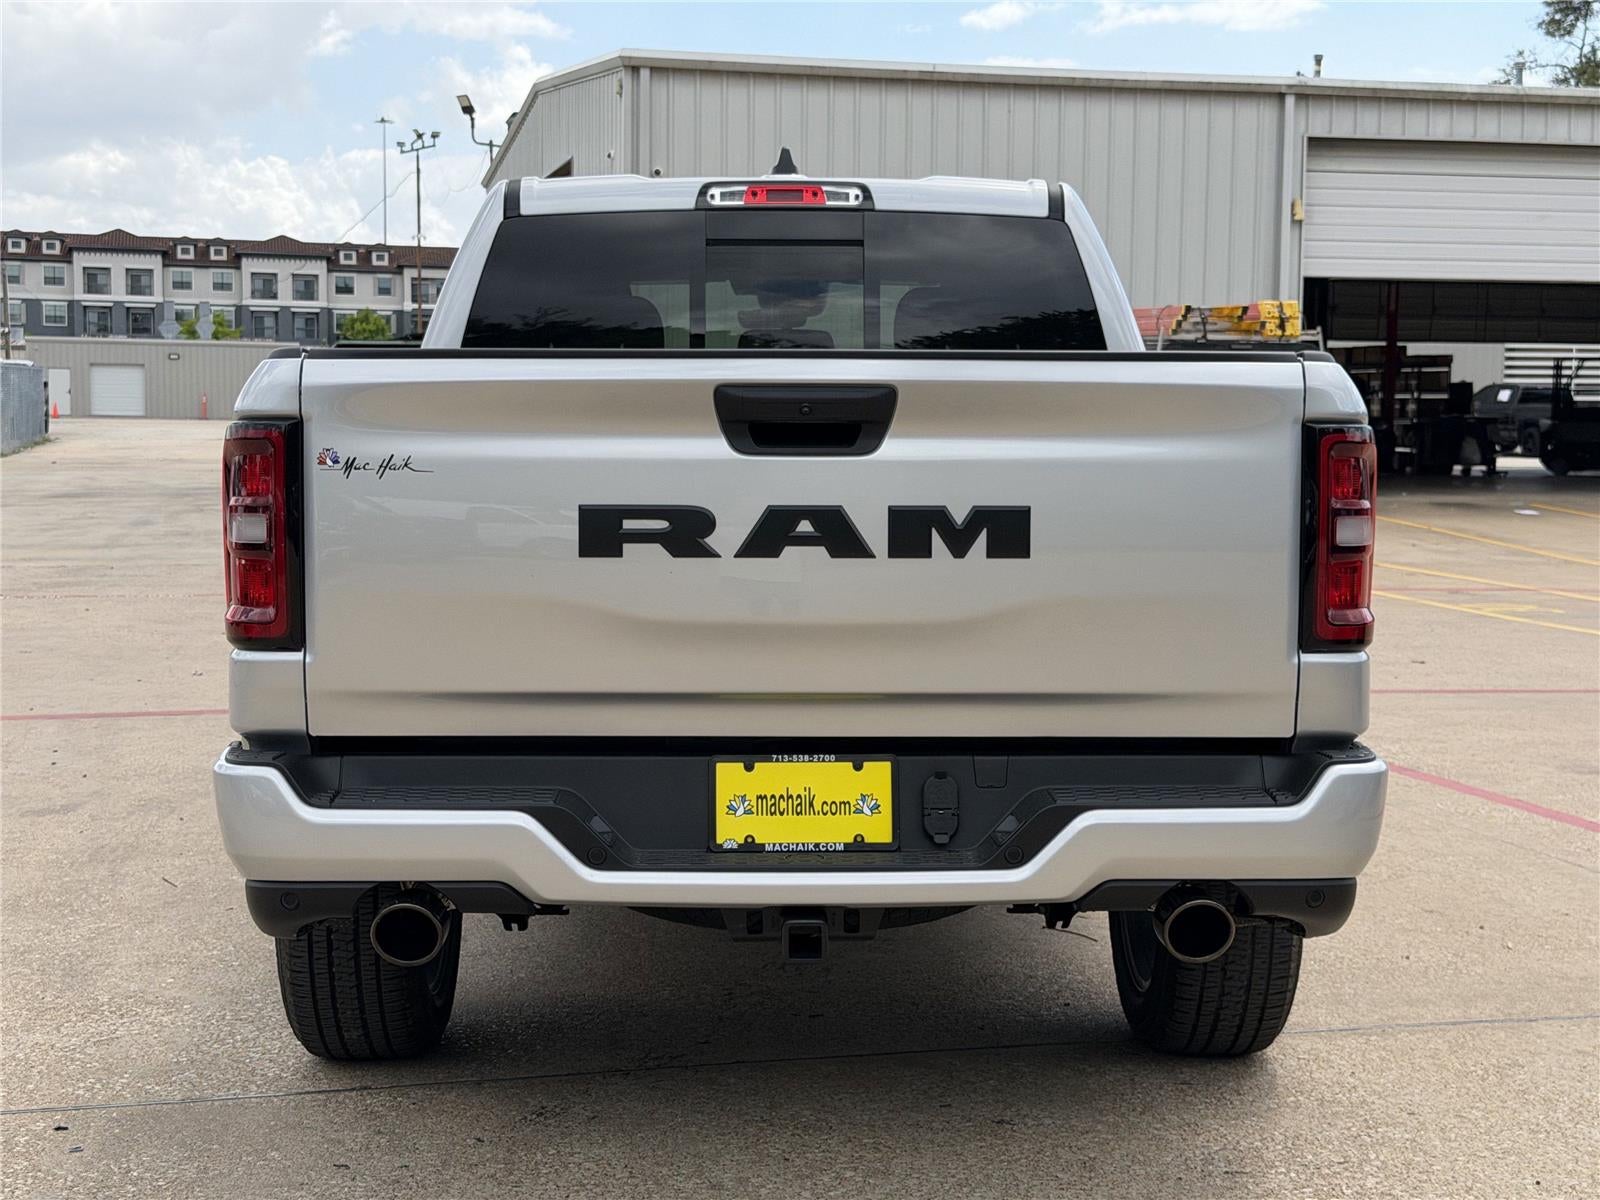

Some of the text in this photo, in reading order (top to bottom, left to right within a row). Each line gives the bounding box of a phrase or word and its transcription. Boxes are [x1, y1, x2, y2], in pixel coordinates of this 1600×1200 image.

[341, 453, 434, 480] Mac Haik
[578, 504, 1031, 559] RAM
[771, 754, 836, 762] 713-538-2700
[755, 787, 851, 816] machaik.com
[765, 842, 845, 851] MACHAIK.COM
